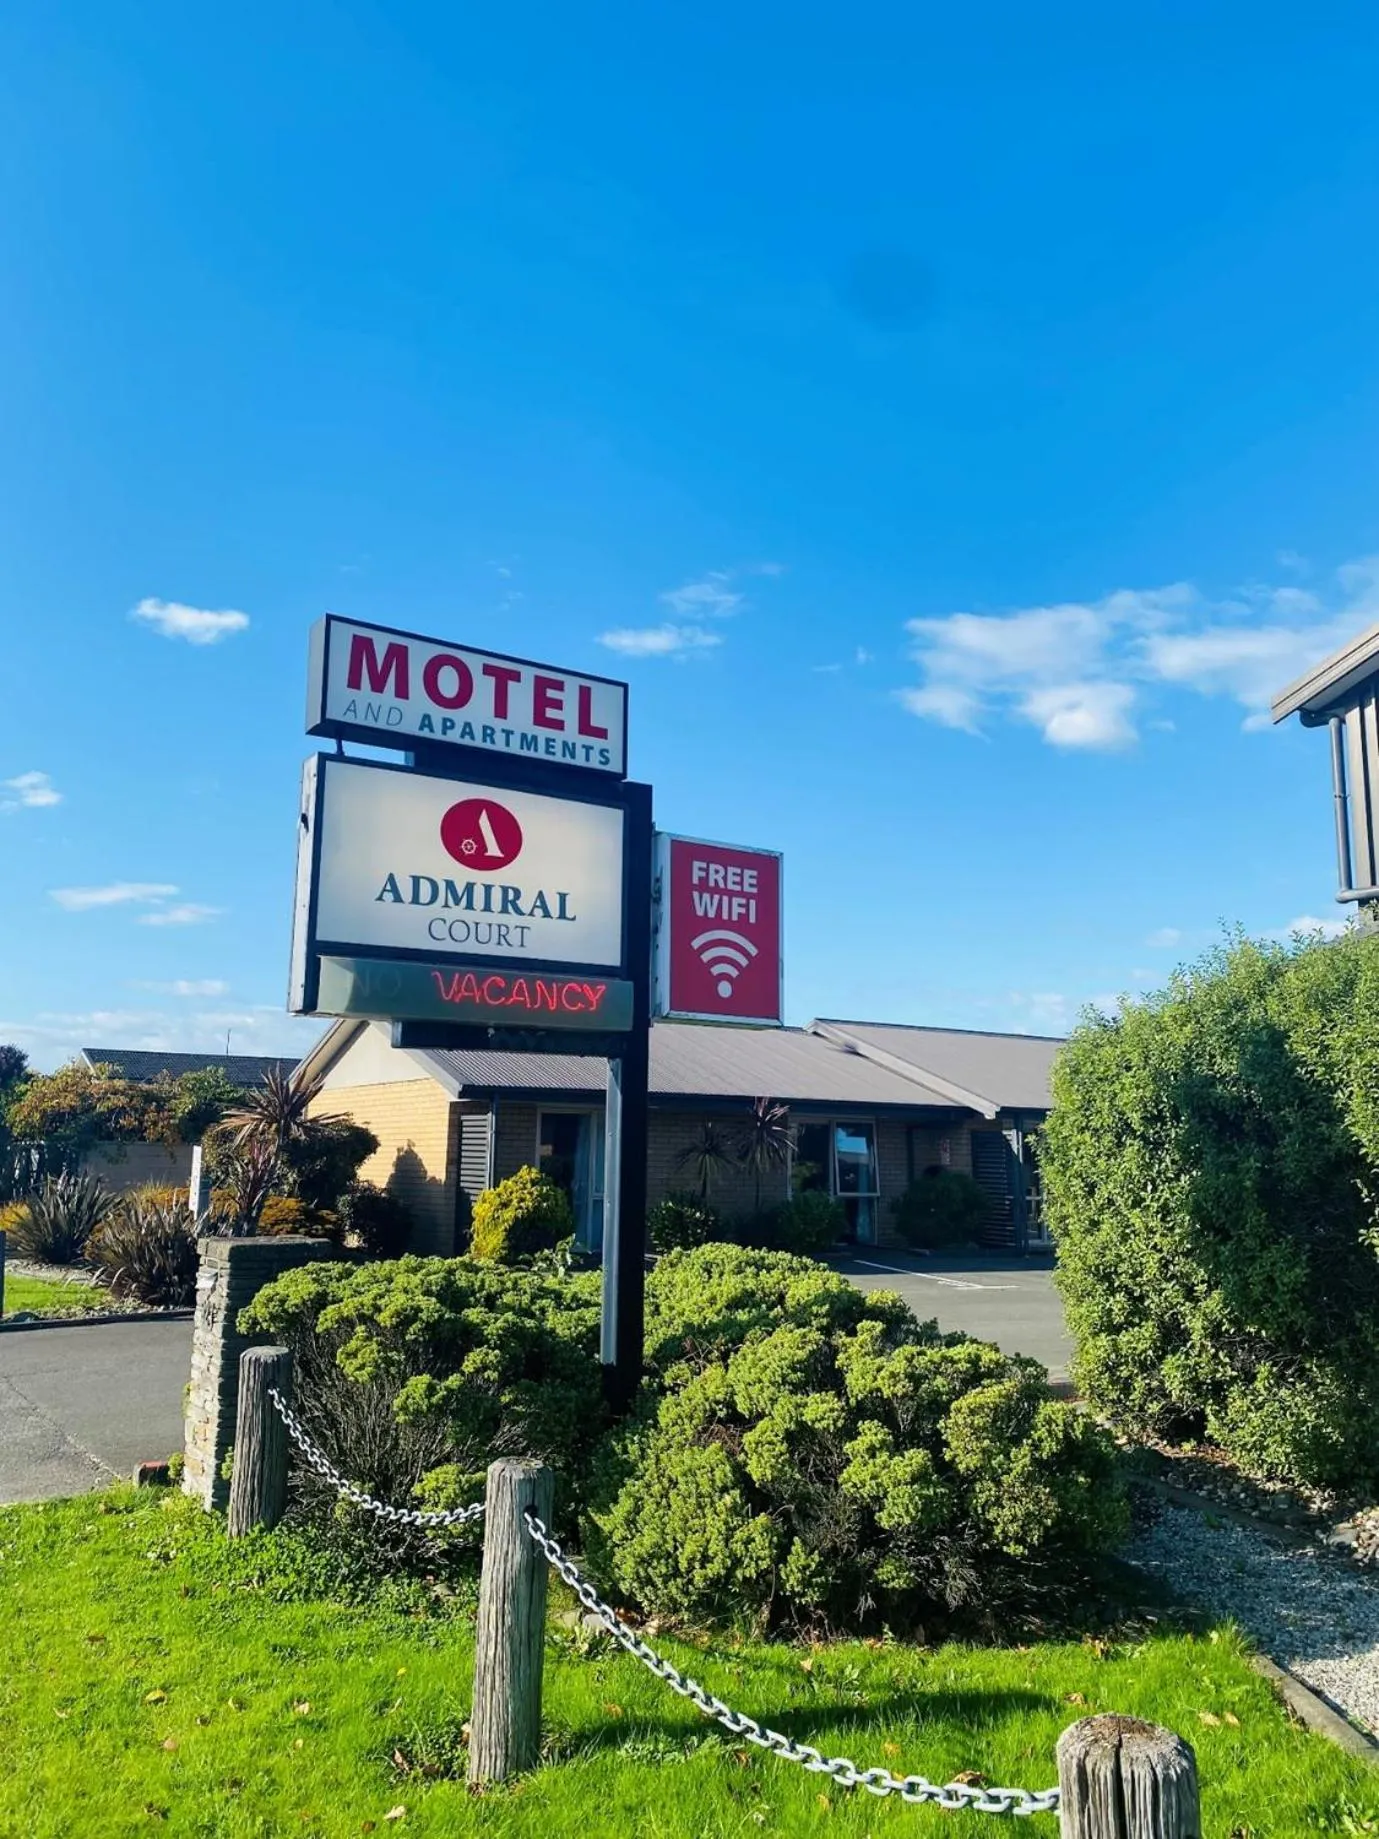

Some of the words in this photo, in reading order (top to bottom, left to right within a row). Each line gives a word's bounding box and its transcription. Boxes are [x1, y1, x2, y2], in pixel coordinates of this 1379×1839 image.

[347, 635, 609, 739] MOTEL
[345, 699, 404, 727] AND
[419, 713, 611, 766] APARTMENTS
[692, 861, 758, 892] FREE
[375, 873, 577, 922] ADMIRAL
[692, 892, 757, 924] WIFI
[428, 918, 531, 948] COURT
[431, 971, 606, 1011] VACANCY
